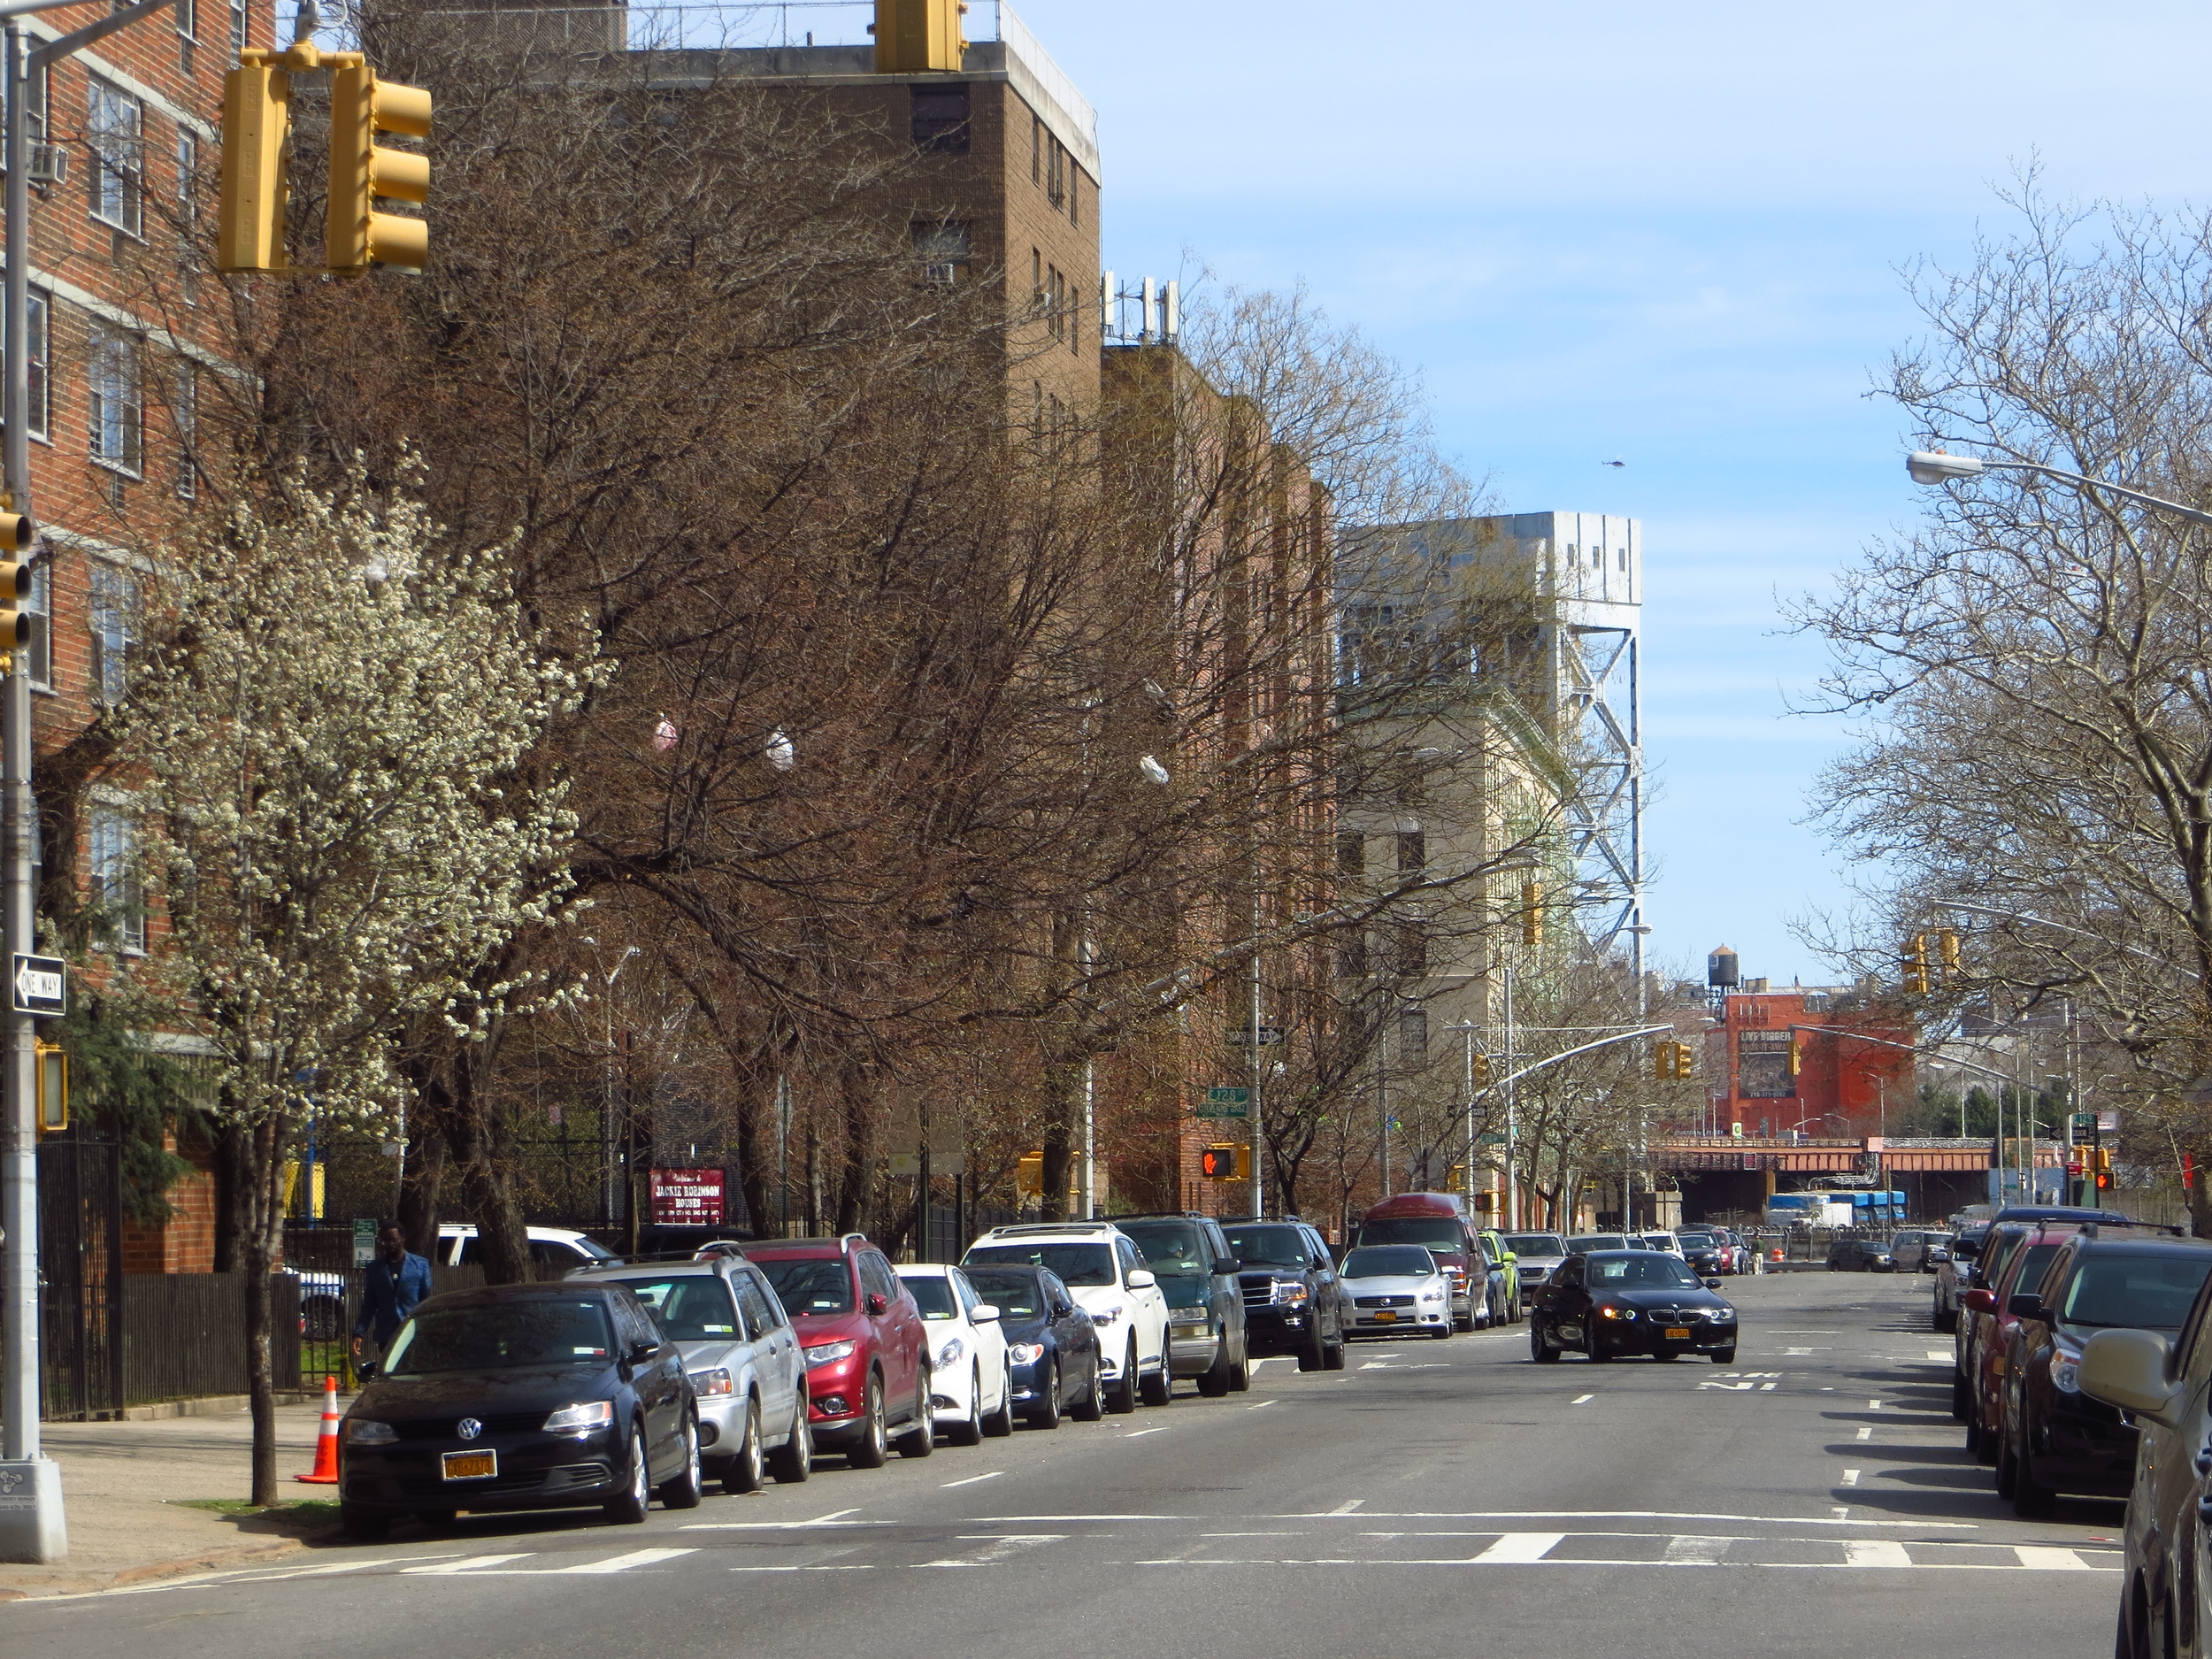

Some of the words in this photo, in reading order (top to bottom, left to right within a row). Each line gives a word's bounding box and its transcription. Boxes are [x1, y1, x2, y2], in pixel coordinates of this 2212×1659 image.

[22, 972, 35, 994] ONE
[42, 975, 58, 996] WAY
[1258, 1033, 1275, 1041] WAY
[1740, 1031, 1759, 1041] LIVE
[1760, 1031, 1791, 1041] BIGGER
[1217, 1089, 1236, 1102] 128
[656, 1185, 682, 1197] JACKIE
[683, 1185, 720, 1197] ROBINSON
[675, 1198, 702, 1209] HOUSES
